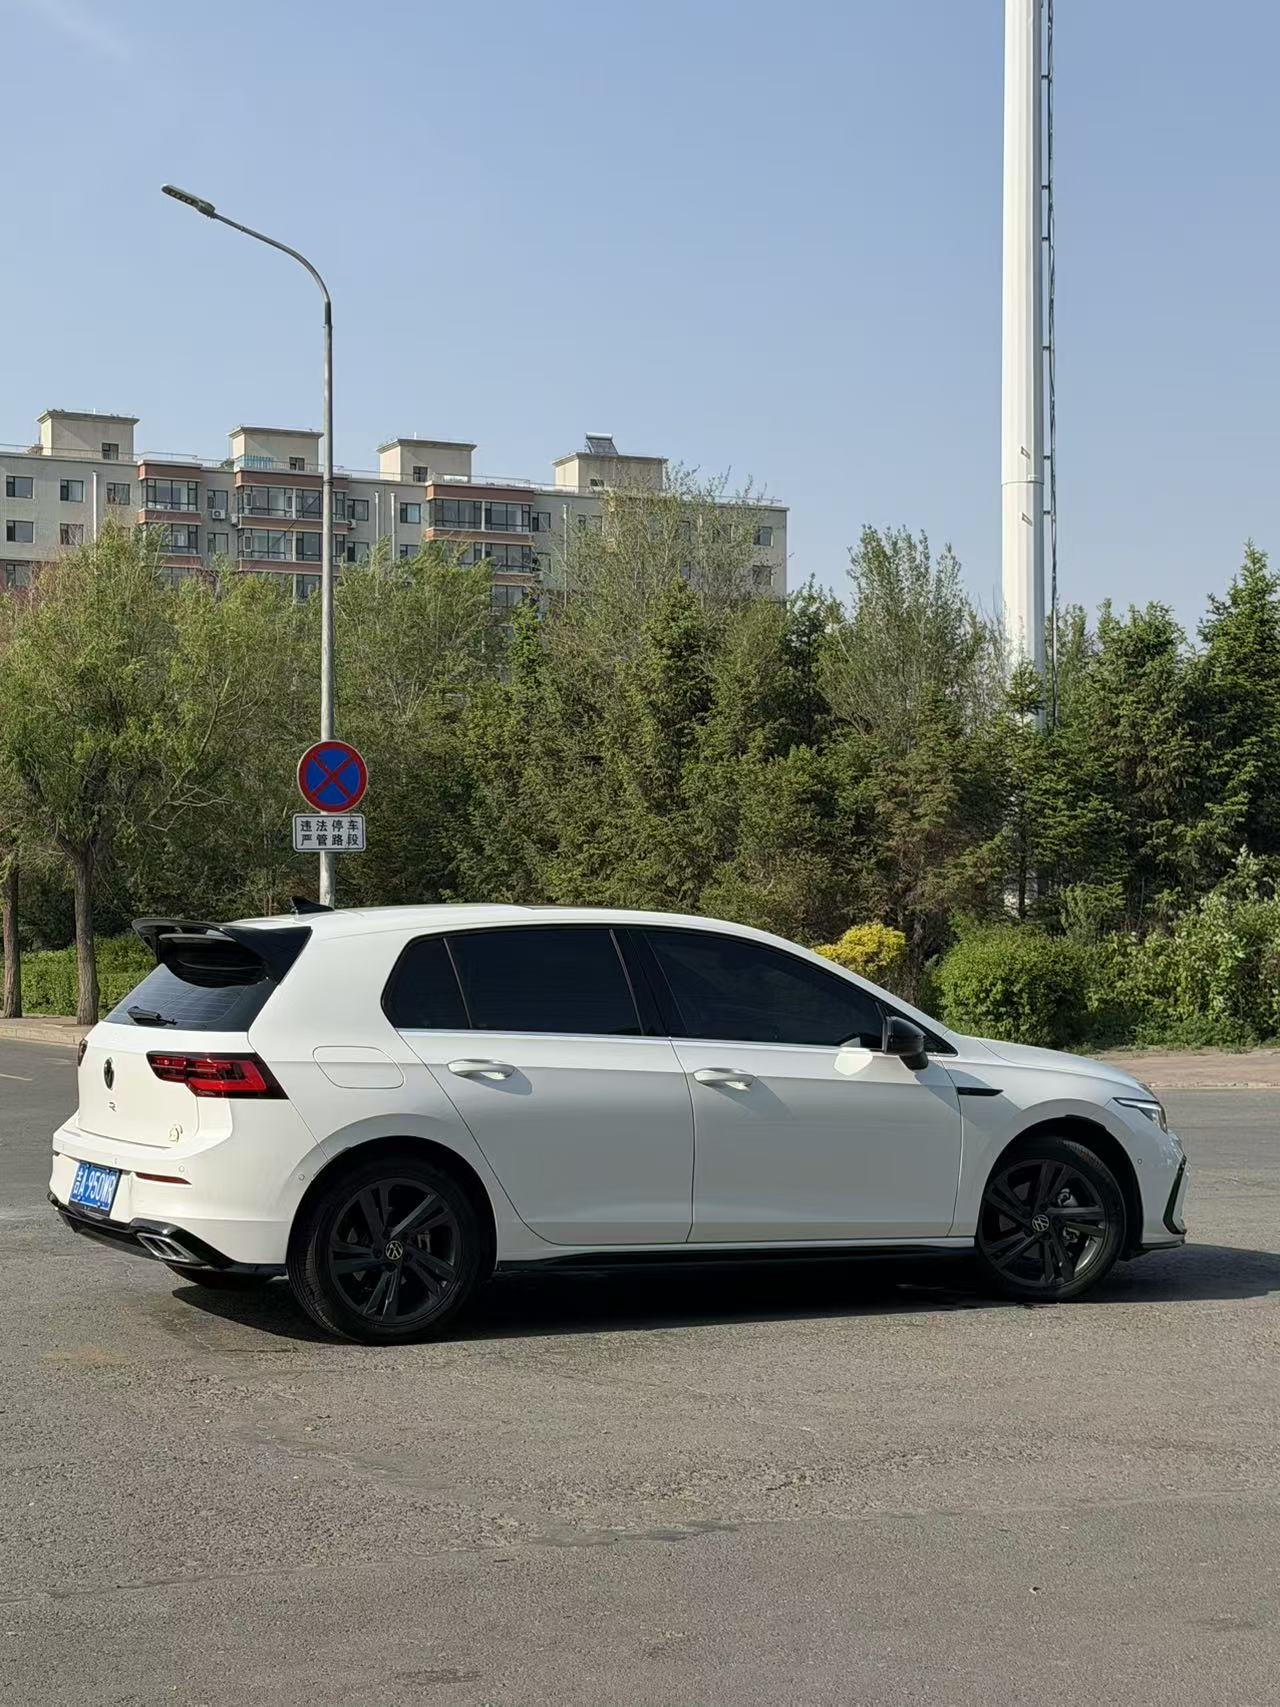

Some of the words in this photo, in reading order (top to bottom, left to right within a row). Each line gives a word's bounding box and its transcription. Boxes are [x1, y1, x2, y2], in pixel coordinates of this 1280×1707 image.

[300, 820, 359, 832] 违法停车
[300, 834, 359, 846] 严管路段
